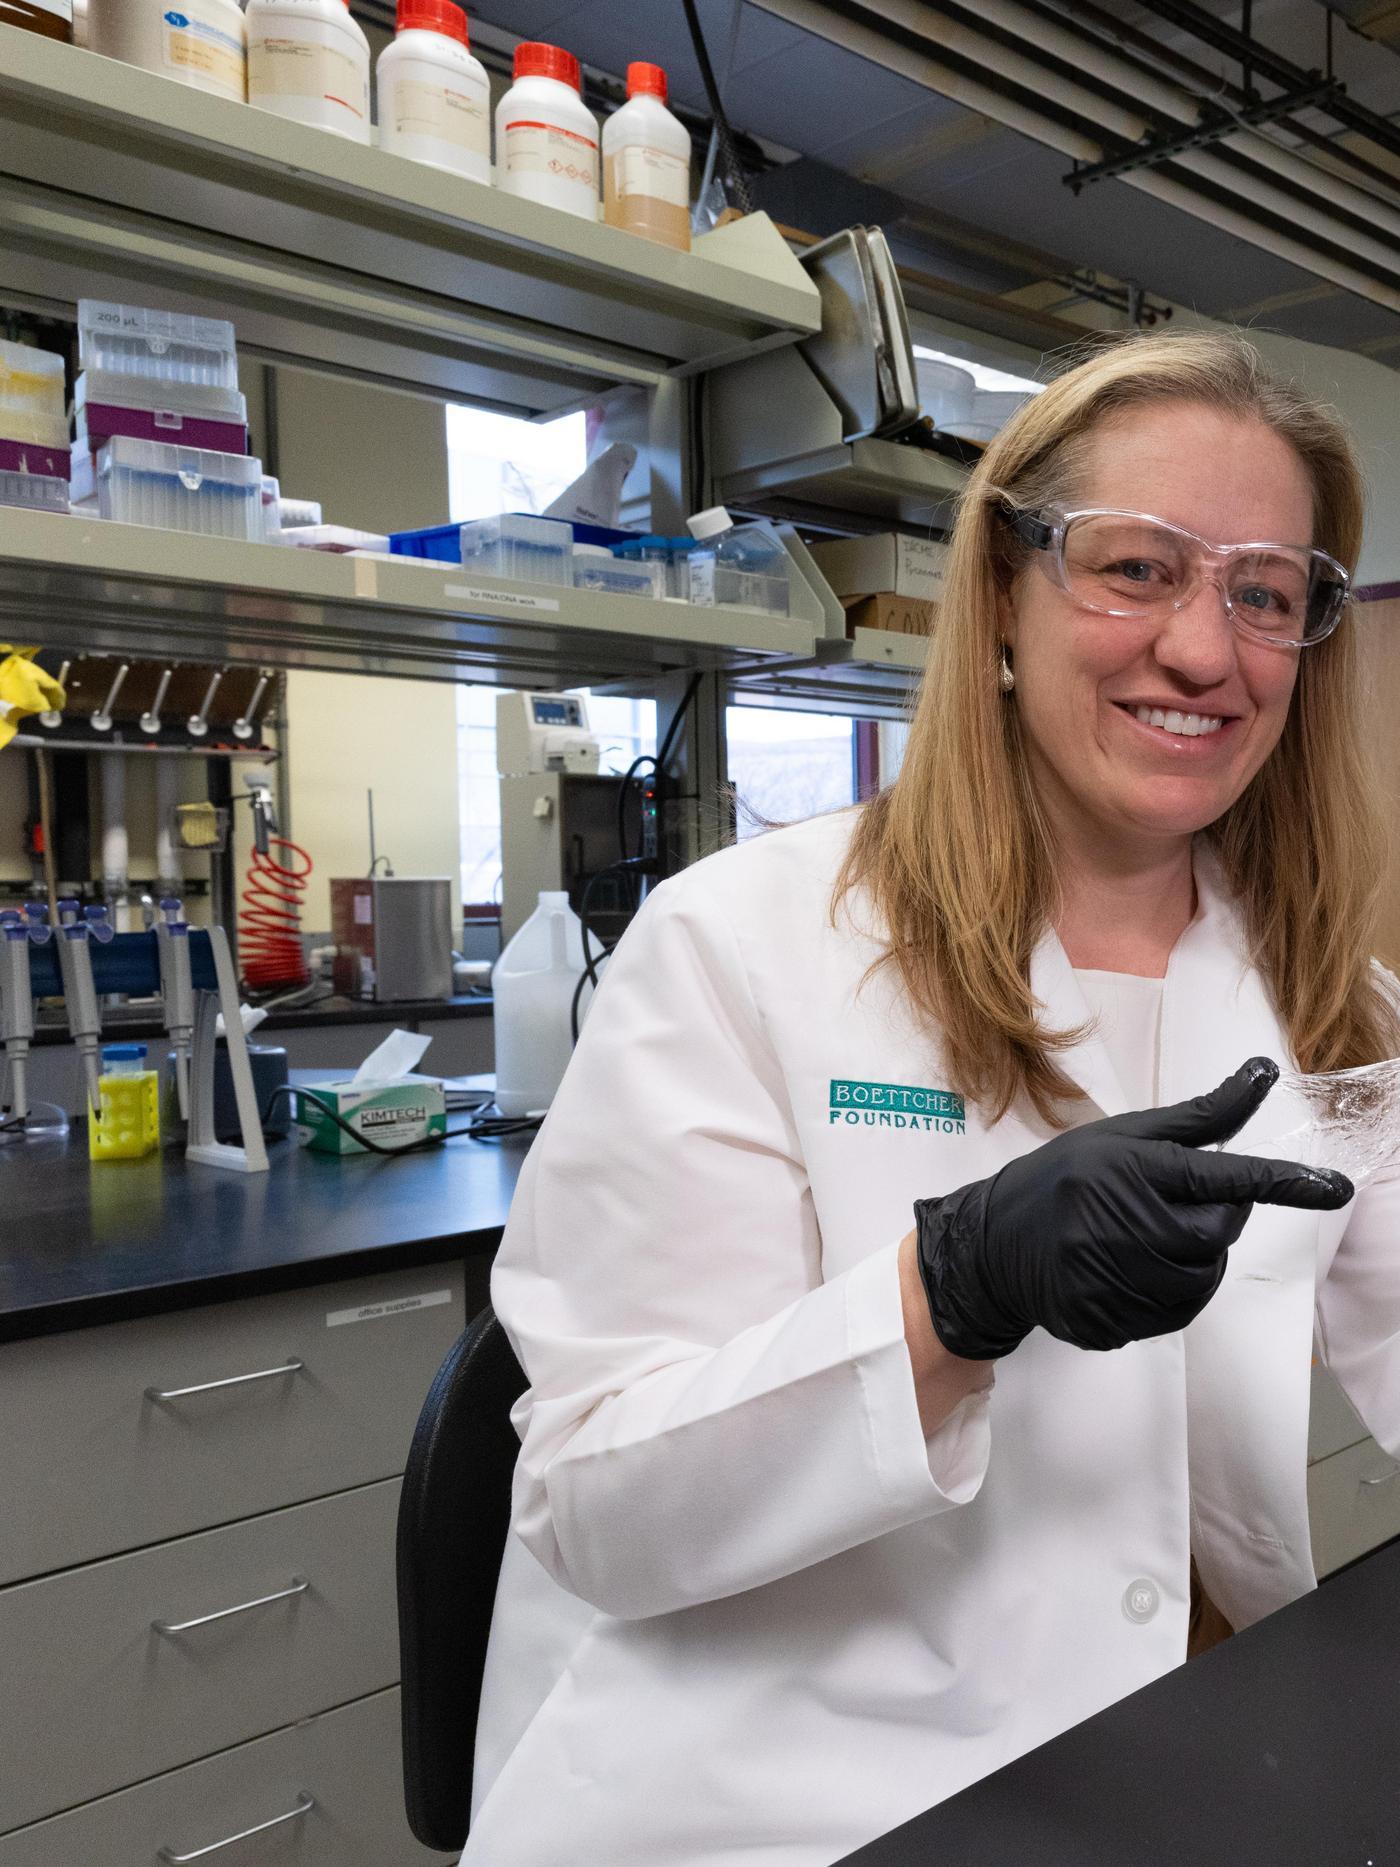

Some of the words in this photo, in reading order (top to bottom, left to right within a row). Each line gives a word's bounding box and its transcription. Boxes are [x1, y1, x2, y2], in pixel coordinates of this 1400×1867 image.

[97, 312, 120, 324] 200
[835, 1084, 962, 1114] BOETTCHER
[361, 1106, 426, 1124] KIMTECH
[829, 1110, 966, 1135] FOUNDATION
